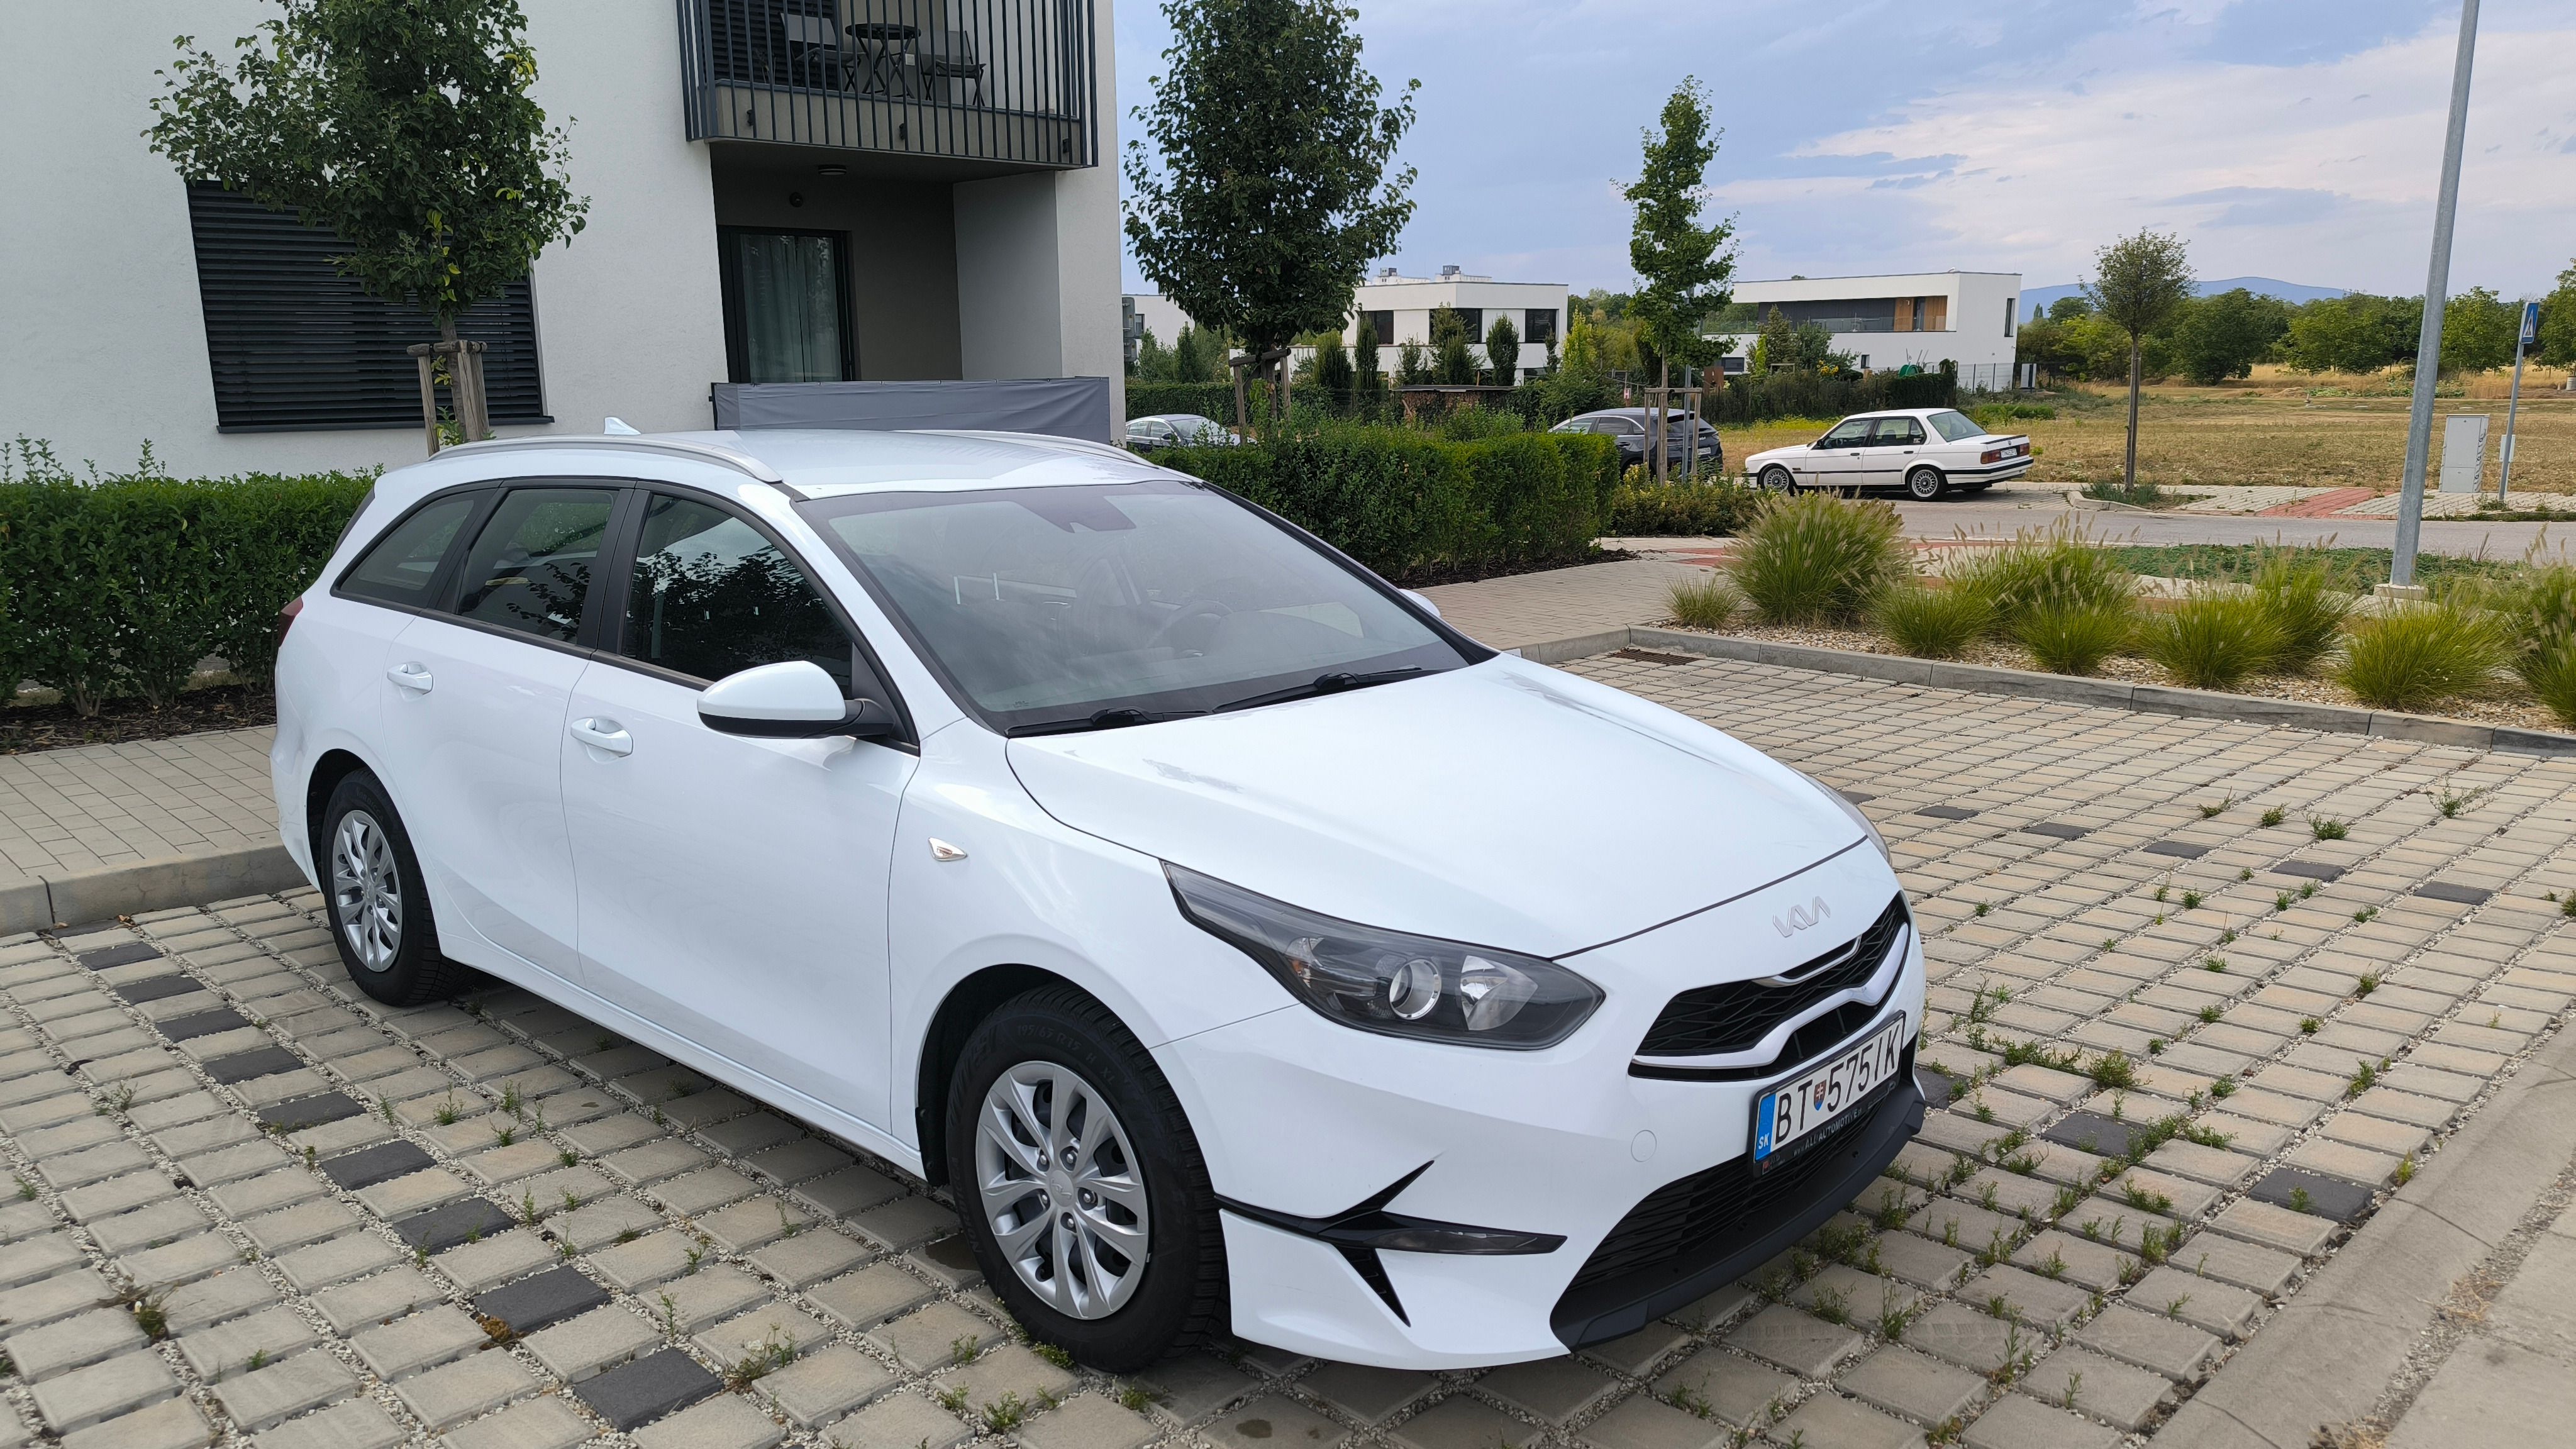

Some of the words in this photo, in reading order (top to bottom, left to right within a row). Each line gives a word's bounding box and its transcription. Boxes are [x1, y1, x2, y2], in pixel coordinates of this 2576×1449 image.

[1773, 896, 1831, 938] KIA
[1775, 1079, 1813, 1145] BT
[1758, 1133, 1770, 1150] SK
